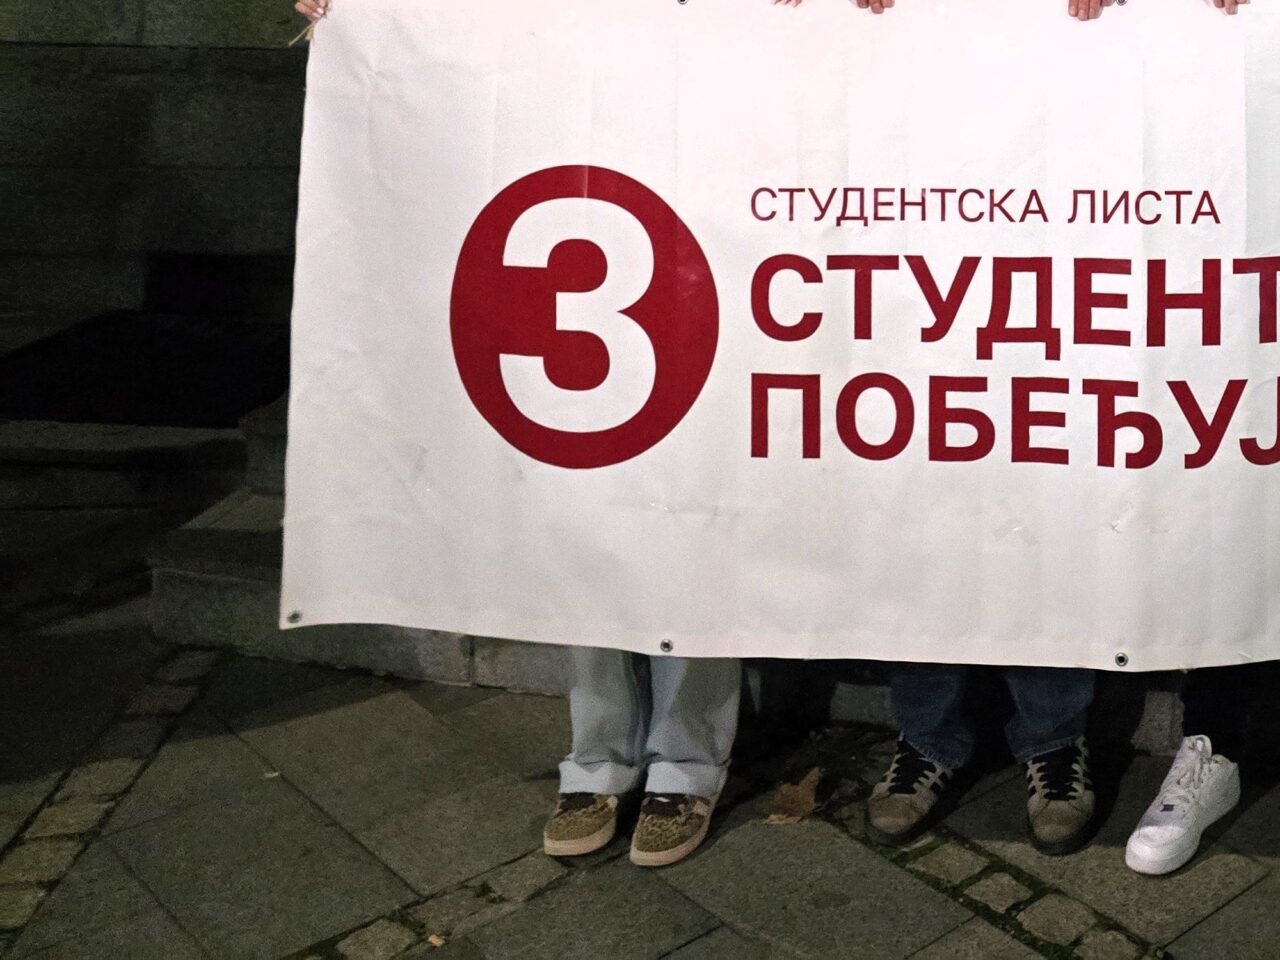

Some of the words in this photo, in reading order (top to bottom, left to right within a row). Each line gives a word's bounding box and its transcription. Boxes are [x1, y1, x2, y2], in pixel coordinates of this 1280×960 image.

[750, 187, 1049, 226] СТУДЕНТСКА
[1067, 189, 1220, 225] ЛИСТА
[498, 197, 656, 433] 3
